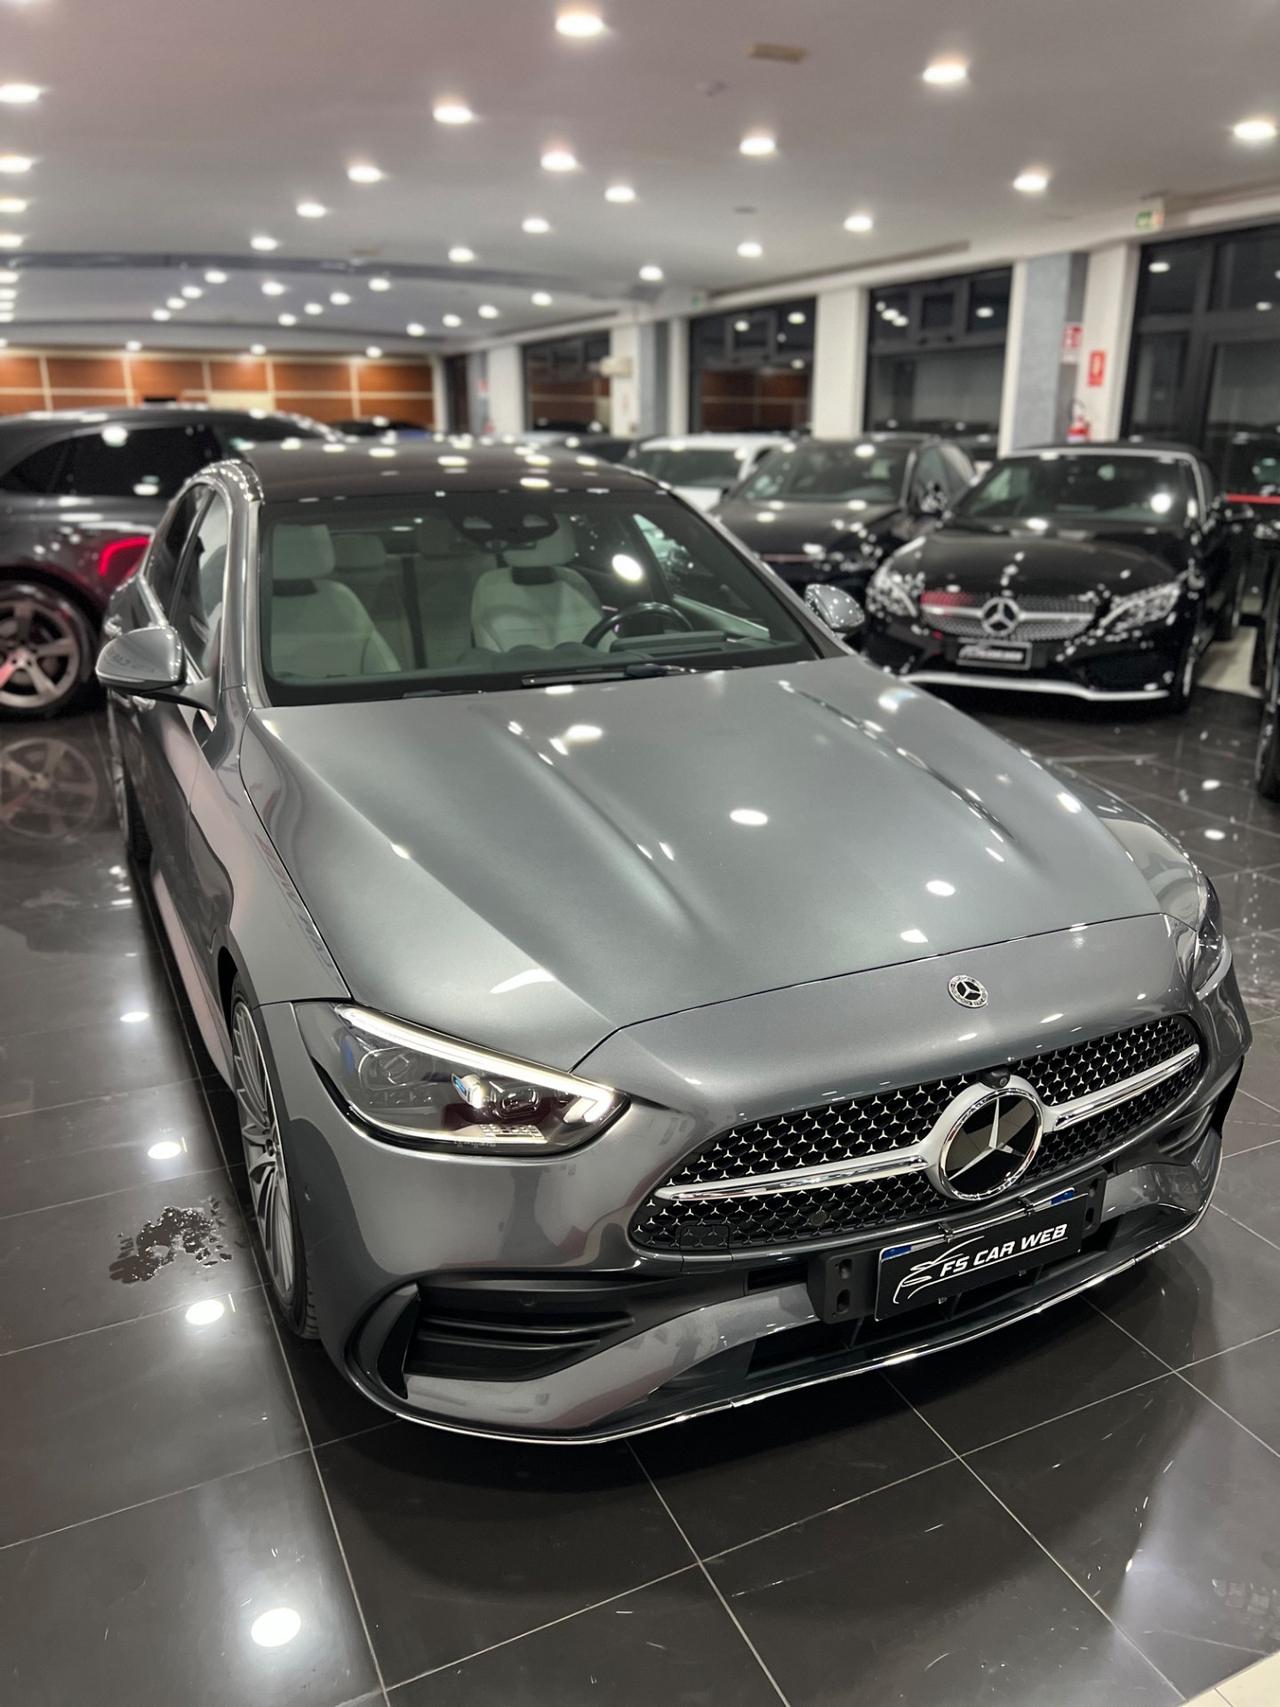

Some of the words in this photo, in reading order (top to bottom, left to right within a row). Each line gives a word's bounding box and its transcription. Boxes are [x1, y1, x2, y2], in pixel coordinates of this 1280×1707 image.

[940, 1256, 970, 1277] FS
[973, 1241, 1016, 1266] CAR
[1021, 1223, 1068, 1250] WEB
